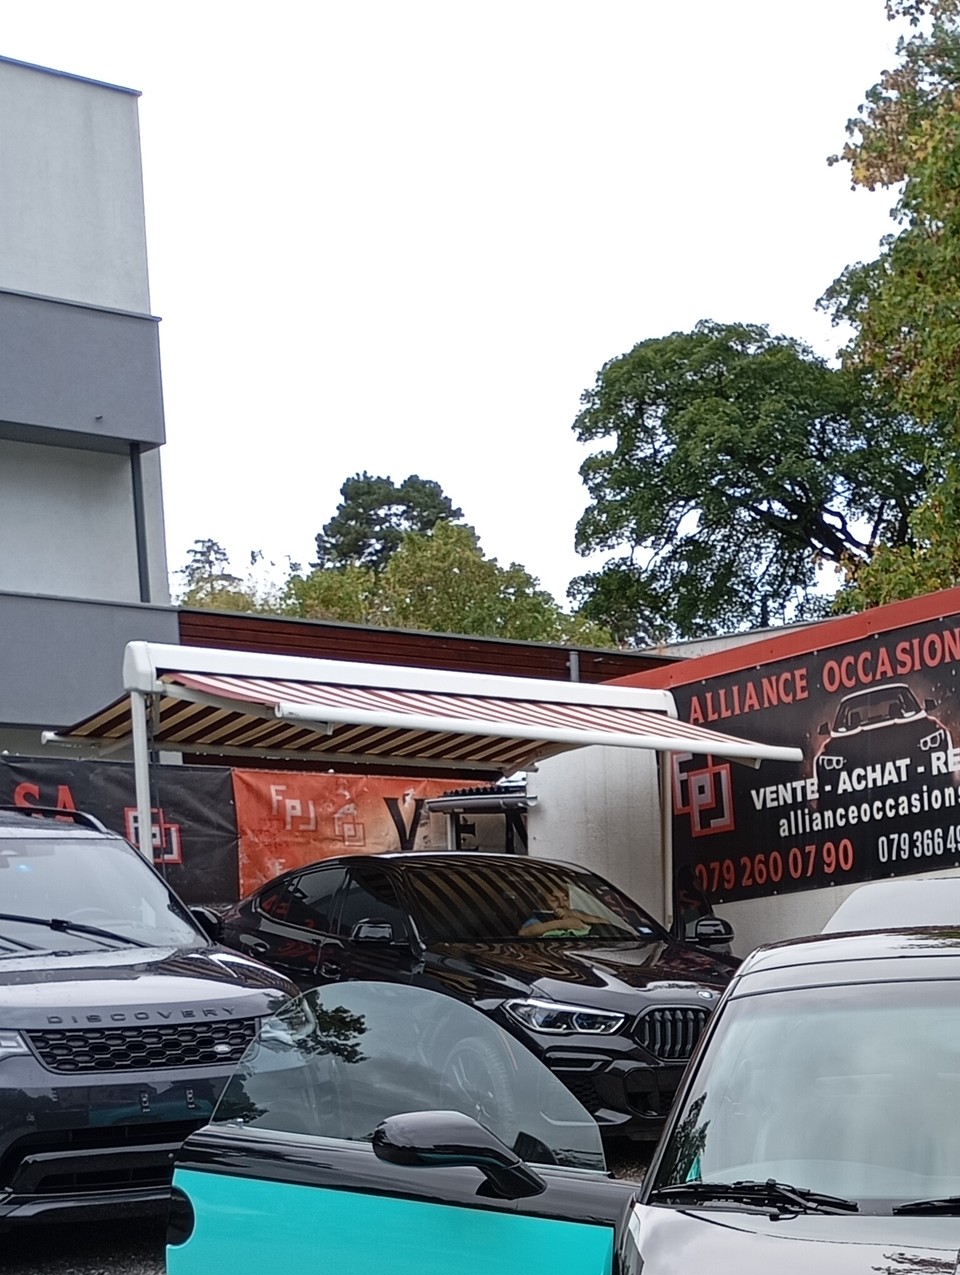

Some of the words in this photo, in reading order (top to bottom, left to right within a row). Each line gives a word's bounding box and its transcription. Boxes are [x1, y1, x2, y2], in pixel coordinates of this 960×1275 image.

[689, 667, 809, 724] ALLIANCE
[14, 782, 76, 822] SA
[750, 777, 820, 810] VENTE
[837, 757, 911, 795] ACHAT
[695, 858, 736, 892] 079
[740, 850, 783, 887] 260
[788, 844, 816, 880] 07
[822, 838, 854, 874] 90
[878, 832, 910, 863] 079
[913, 828, 944, 858] 366
[46, 1006, 236, 1025] DISCOVERY
